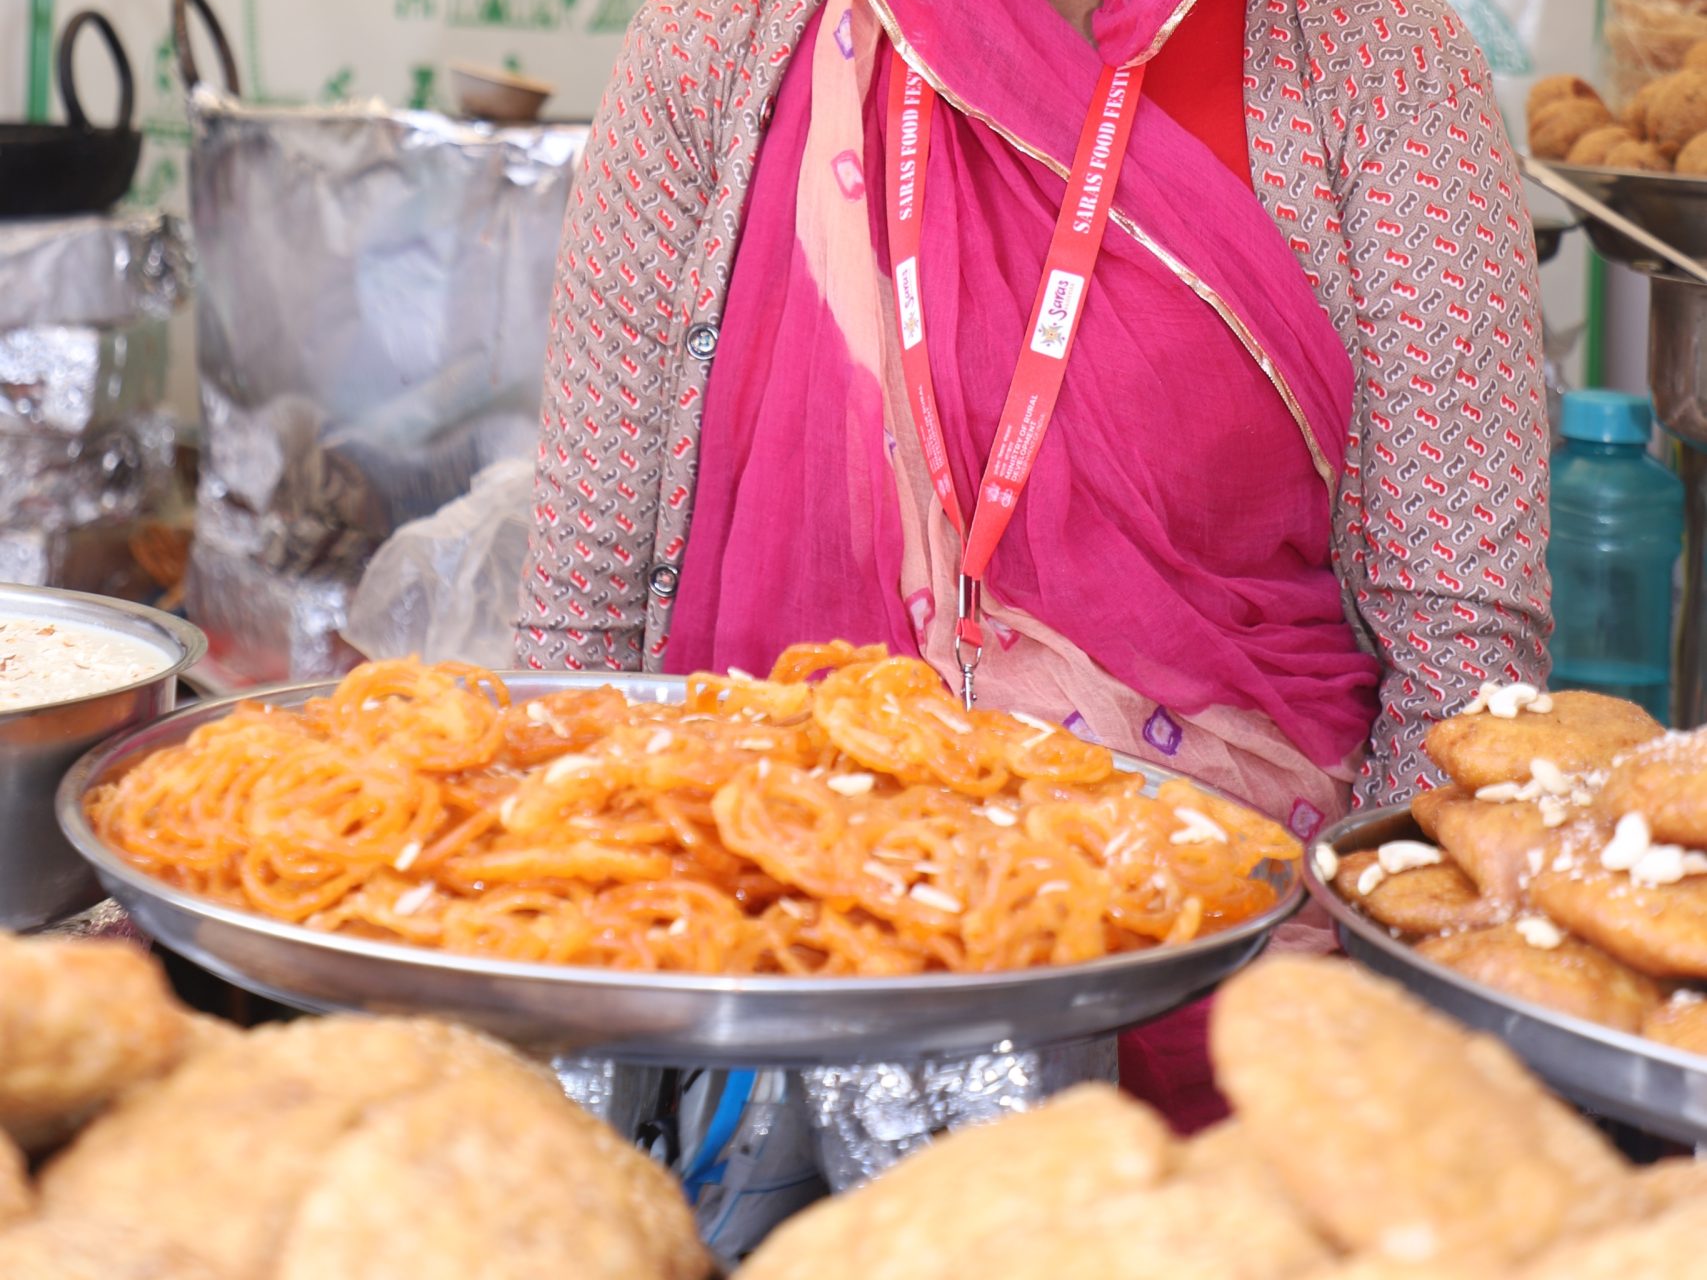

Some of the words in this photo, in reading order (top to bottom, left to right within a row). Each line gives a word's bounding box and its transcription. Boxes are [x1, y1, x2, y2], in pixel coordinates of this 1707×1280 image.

[900, 109, 919, 155] FOOD
[898, 159, 914, 219] SARAS
[1071, 172, 1103, 234] SARAS
[1089, 121, 1117, 170] FOOD
[1048, 280, 1069, 320] Saras
[1005, 439, 1022, 479] MINISTRY
[1019, 424, 1027, 437] OF
[1023, 394, 1038, 423] RURAL
[1011, 421, 1036, 481] DEVELOPMENT
